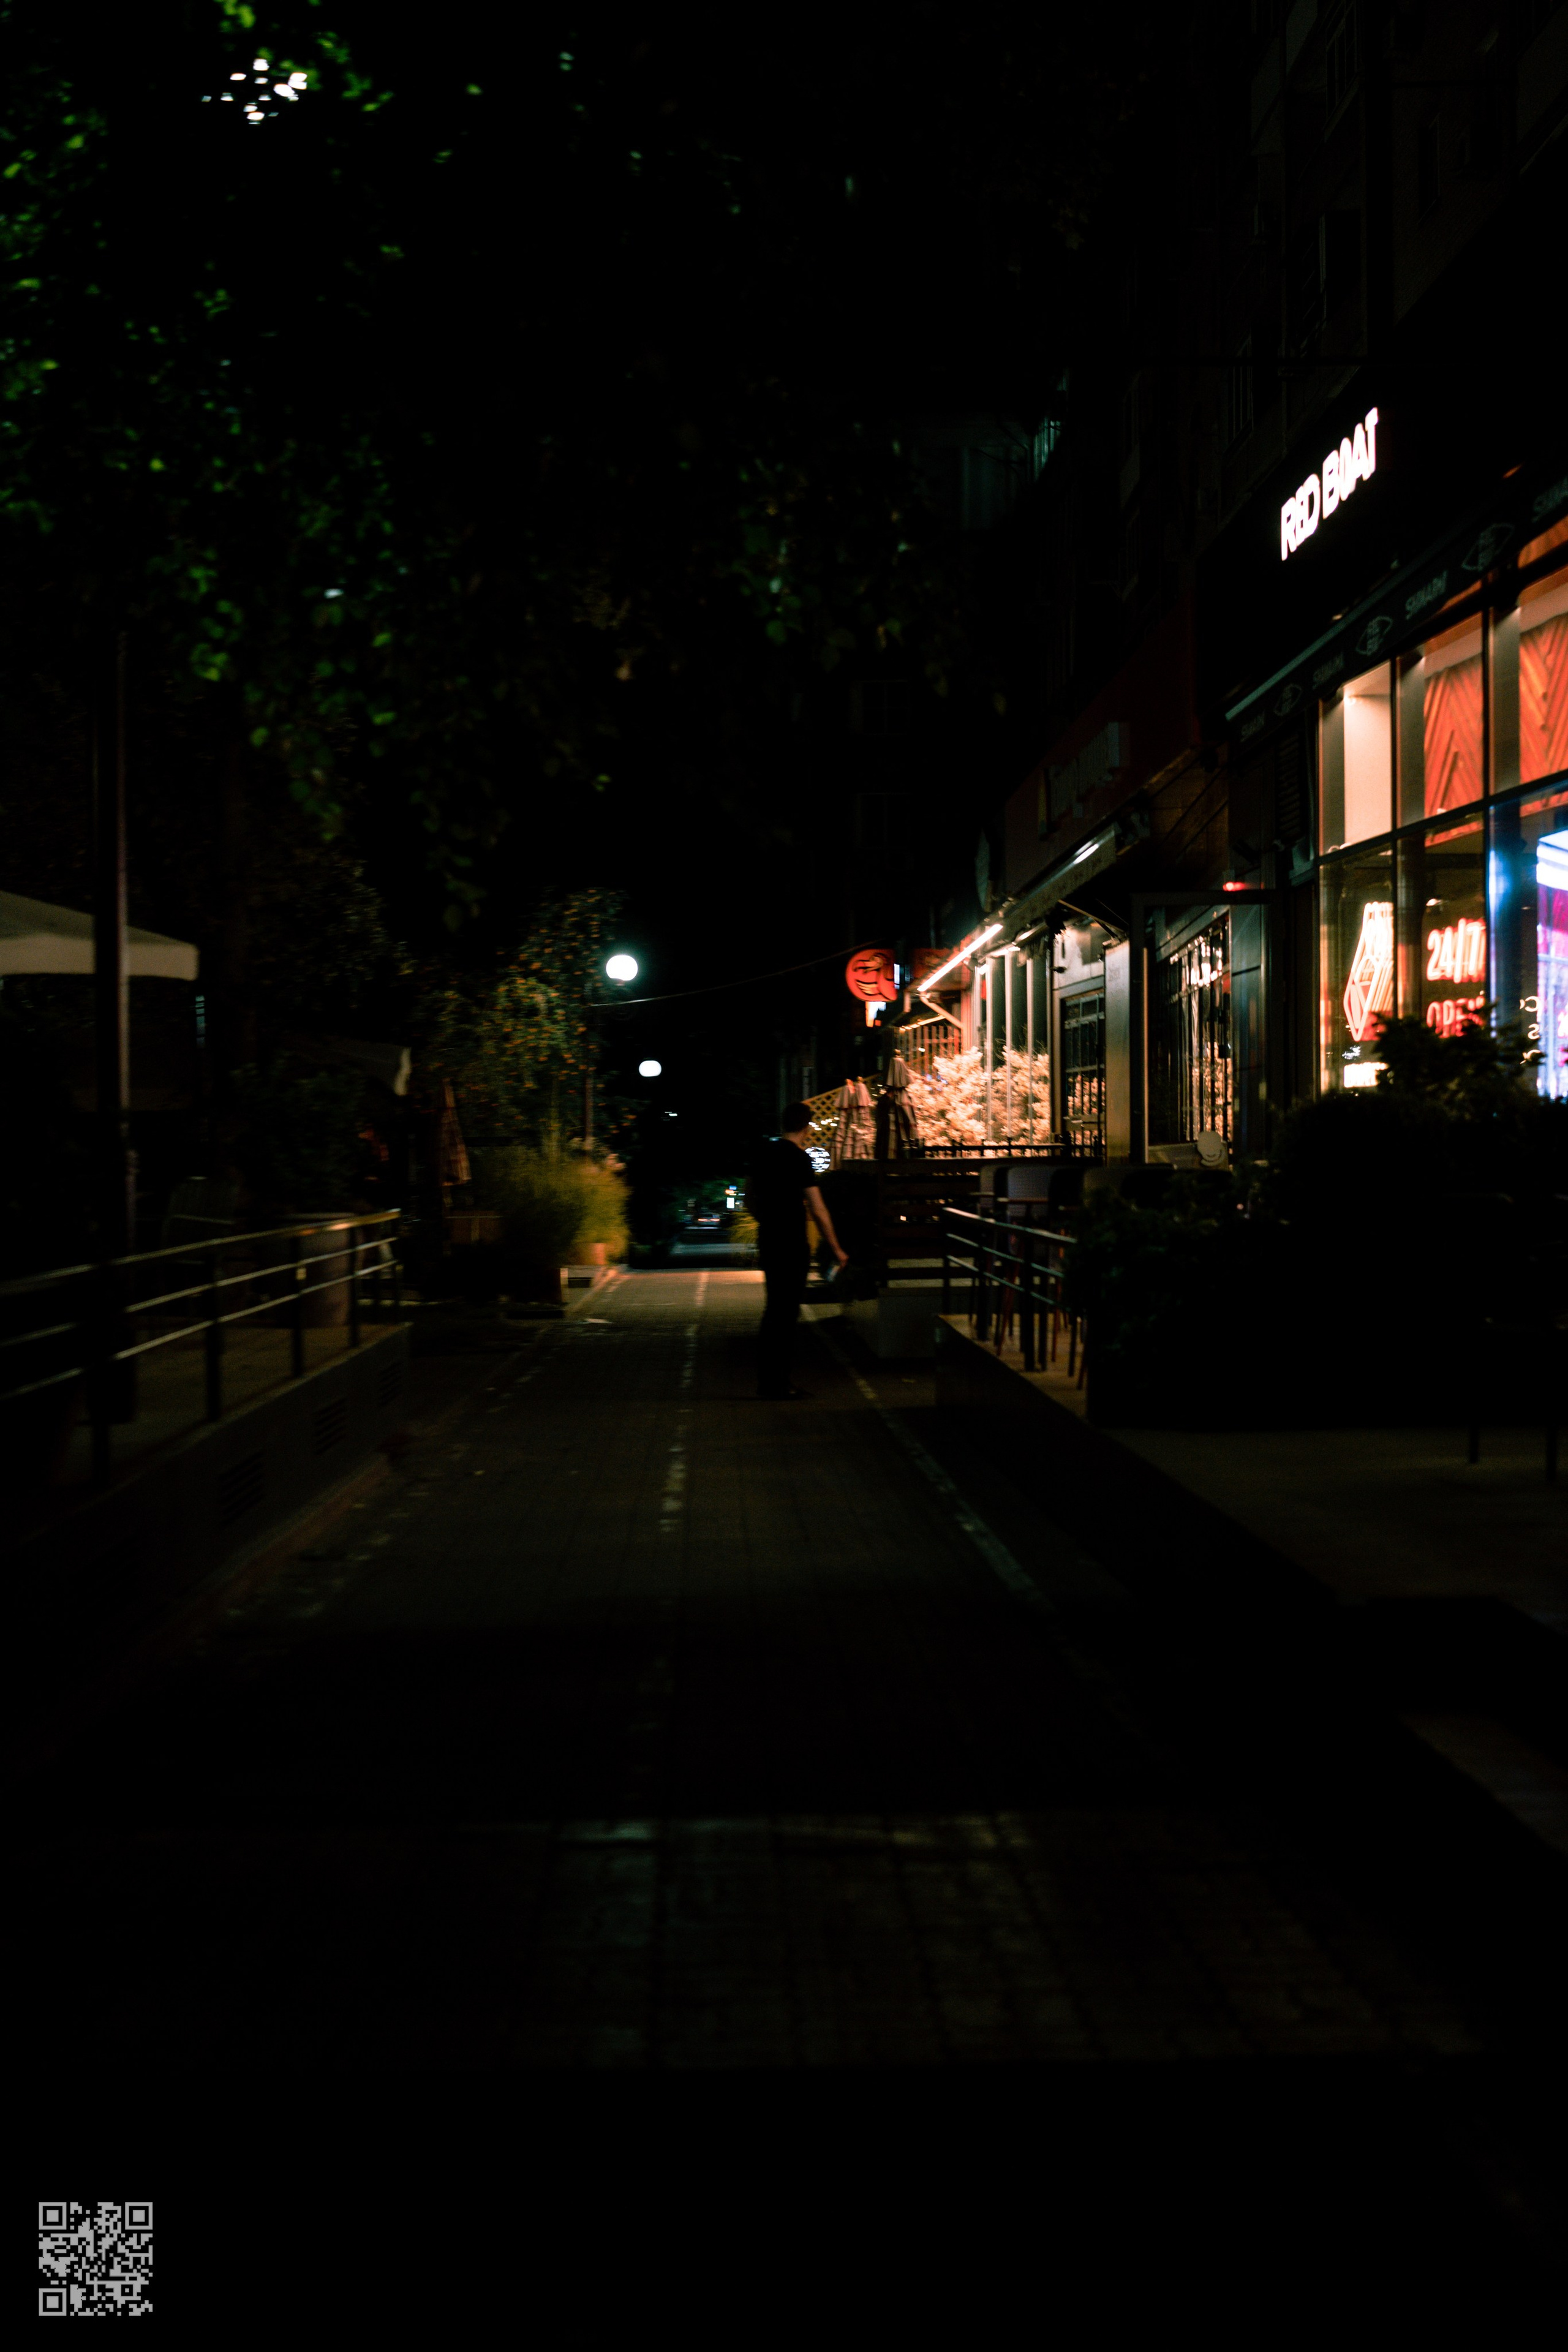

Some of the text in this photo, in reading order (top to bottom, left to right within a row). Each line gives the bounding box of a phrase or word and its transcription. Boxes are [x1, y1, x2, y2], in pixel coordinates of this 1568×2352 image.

[1281, 407, 1378, 561] RED BOAT
[1426, 918, 1486, 984] 24/7
